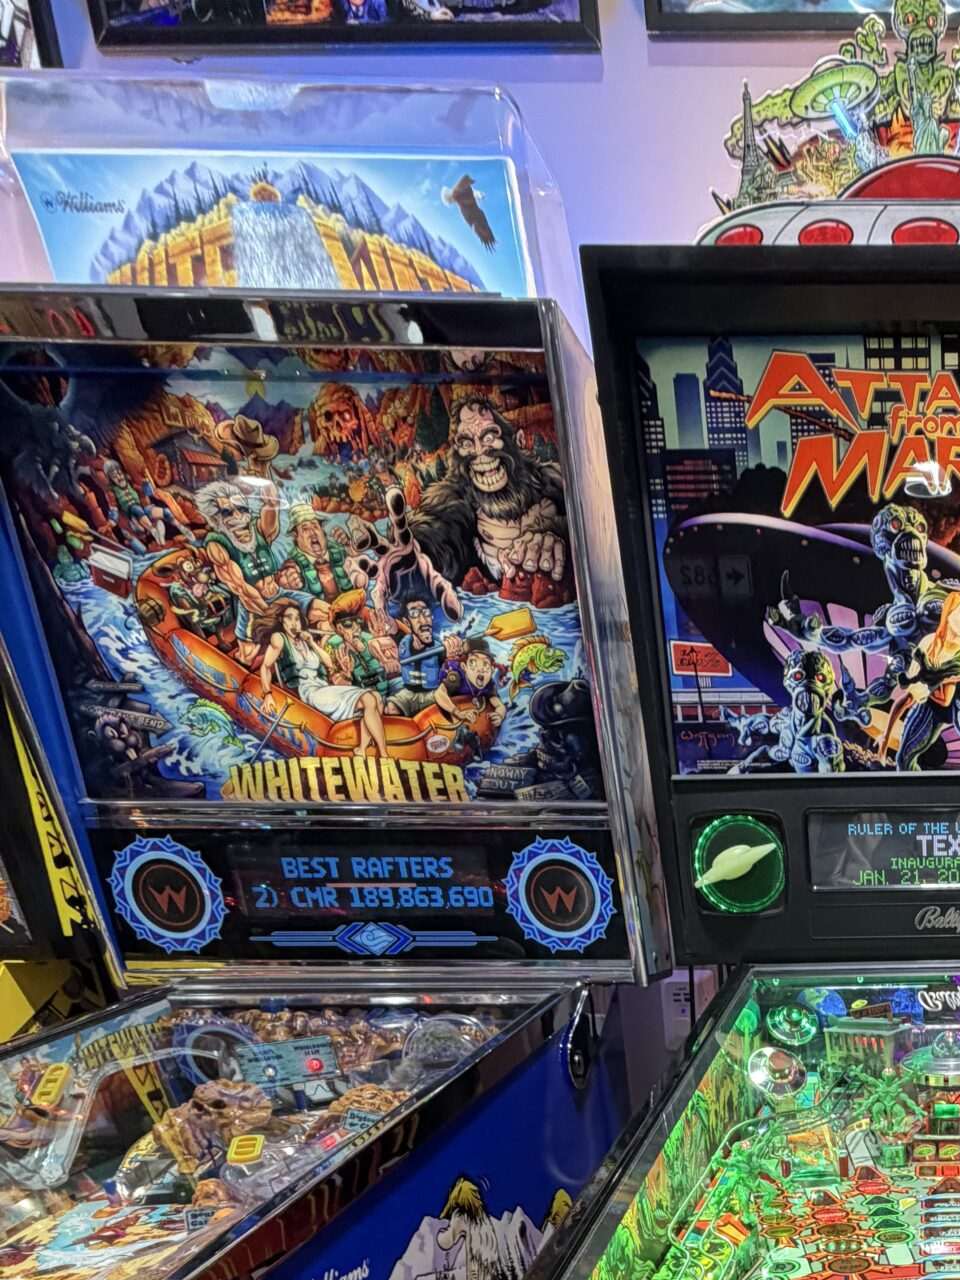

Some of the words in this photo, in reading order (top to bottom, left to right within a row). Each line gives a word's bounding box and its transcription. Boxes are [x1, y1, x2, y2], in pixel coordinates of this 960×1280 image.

[55, 190, 125, 214] Williams
[229, 756, 470, 802] WHITEWATER
[848, 823, 893, 836] RULER
[900, 822, 917, 835] OF
[924, 822, 950, 834] THE
[281, 857, 339, 879] BEST
[351, 857, 454, 879] RAFTERS
[852, 870, 889, 886] JAN.
[252, 886, 278, 908] 2)
[290, 886, 339, 908] CMR
[350, 886, 494, 910] 189,863,690
